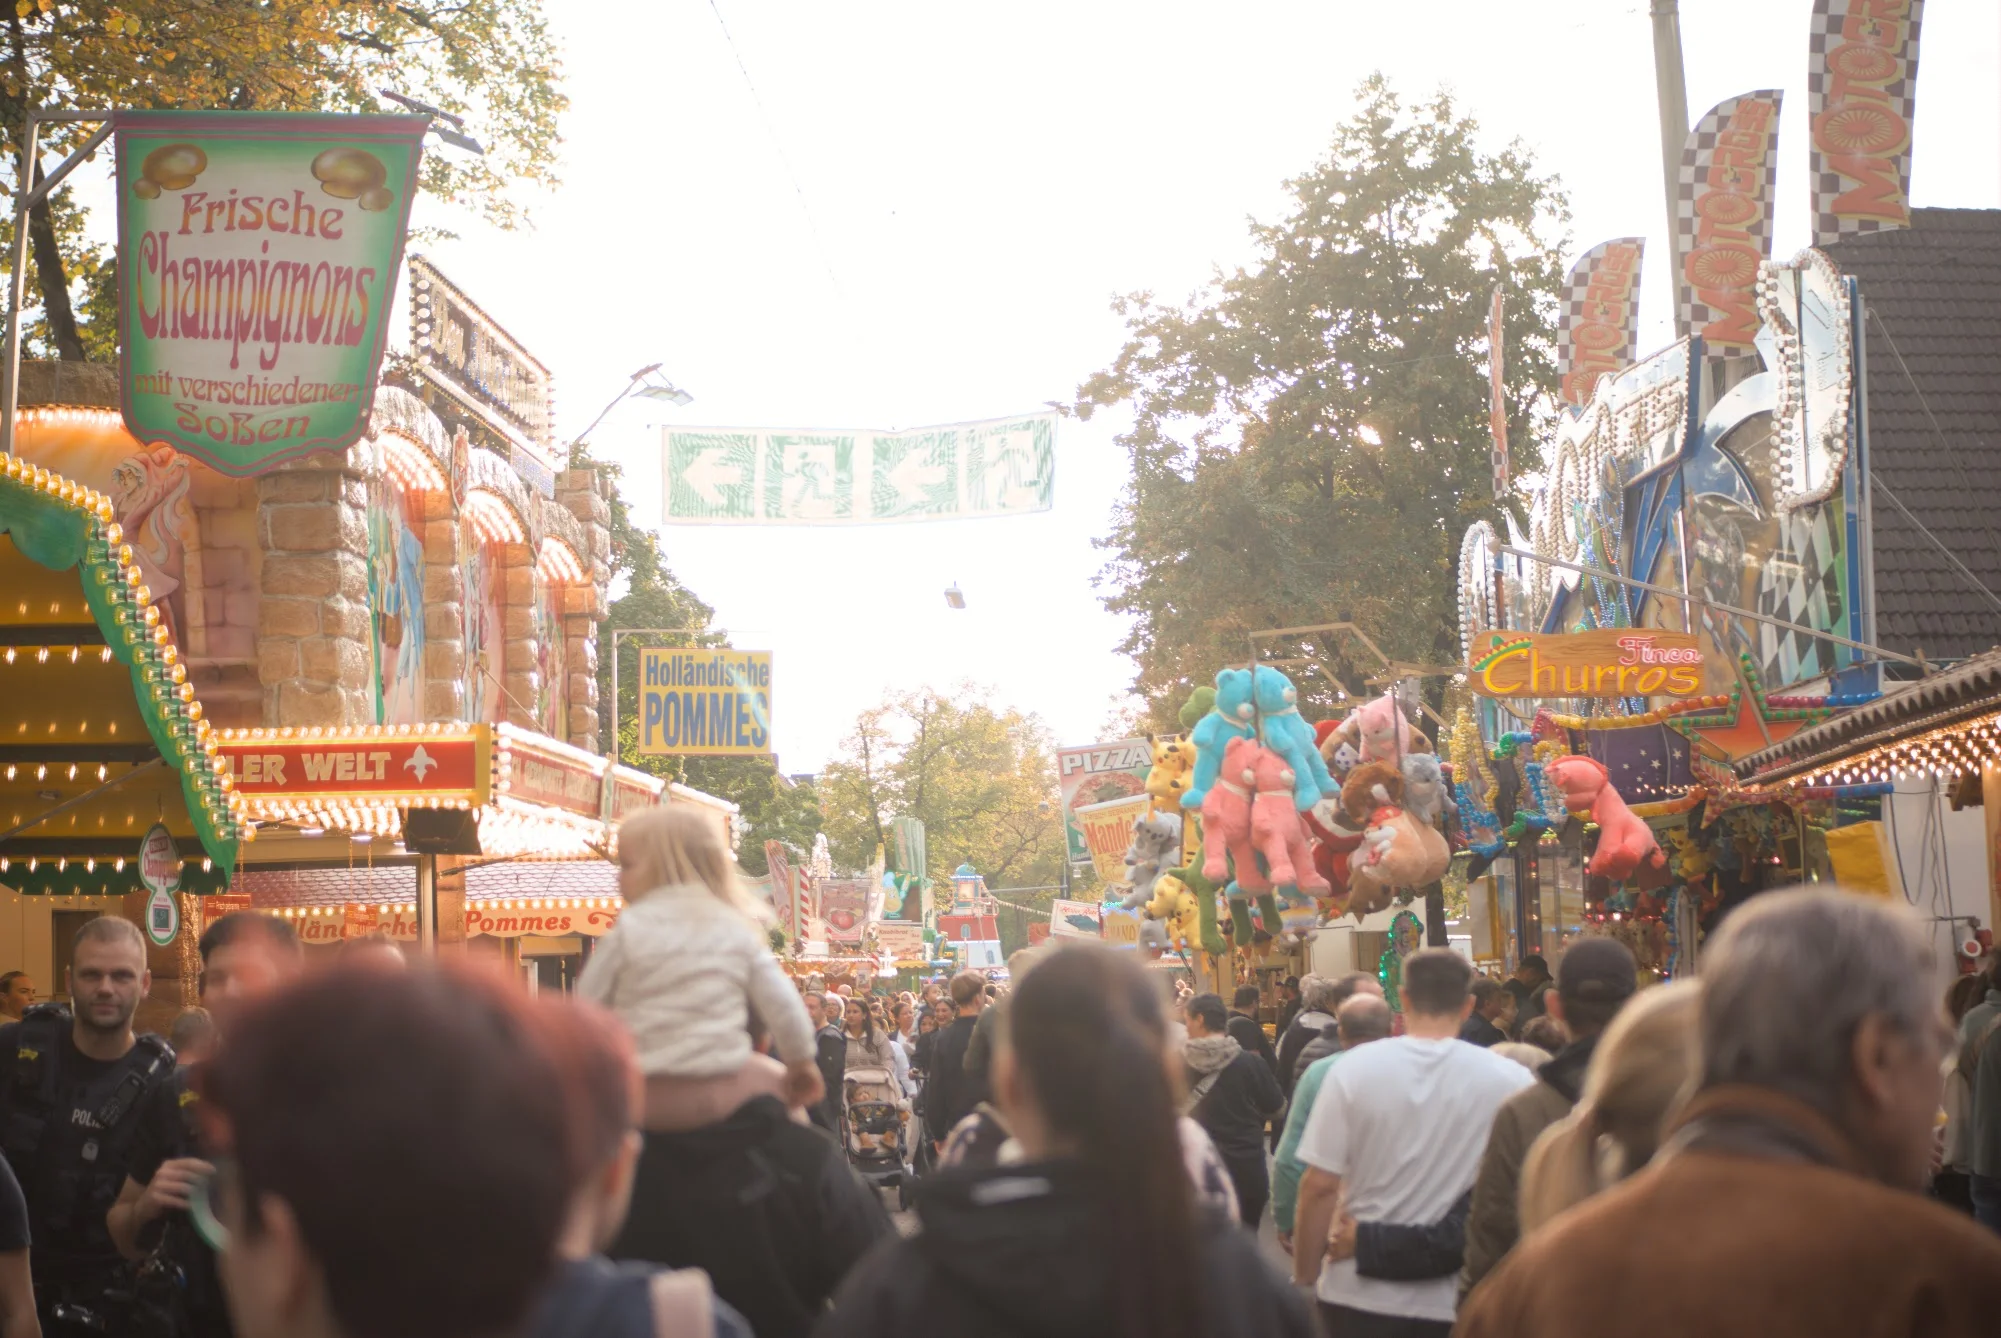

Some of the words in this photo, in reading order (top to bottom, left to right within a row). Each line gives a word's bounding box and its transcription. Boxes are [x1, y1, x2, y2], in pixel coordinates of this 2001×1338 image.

[178, 188, 344, 240] Frische
[1685, 98, 1776, 347] MOTOCROSS
[137, 231, 376, 371] Champignons
[1562, 243, 1640, 405] OTOCROSS
[135, 370, 173, 395] mit
[177, 374, 359, 406] verschiedenen
[174, 402, 311, 446] Soßen
[645, 654, 770, 687] Holländische
[1483, 648, 1699, 694] Churros
[1617, 636, 1702, 665] Finca
[644, 691, 769, 748] POMMES
[223, 754, 288, 786] LER
[301, 751, 392, 782] WELT
[1061, 745, 1153, 776] PIZZA
[466, 910, 571, 933] Pommes
